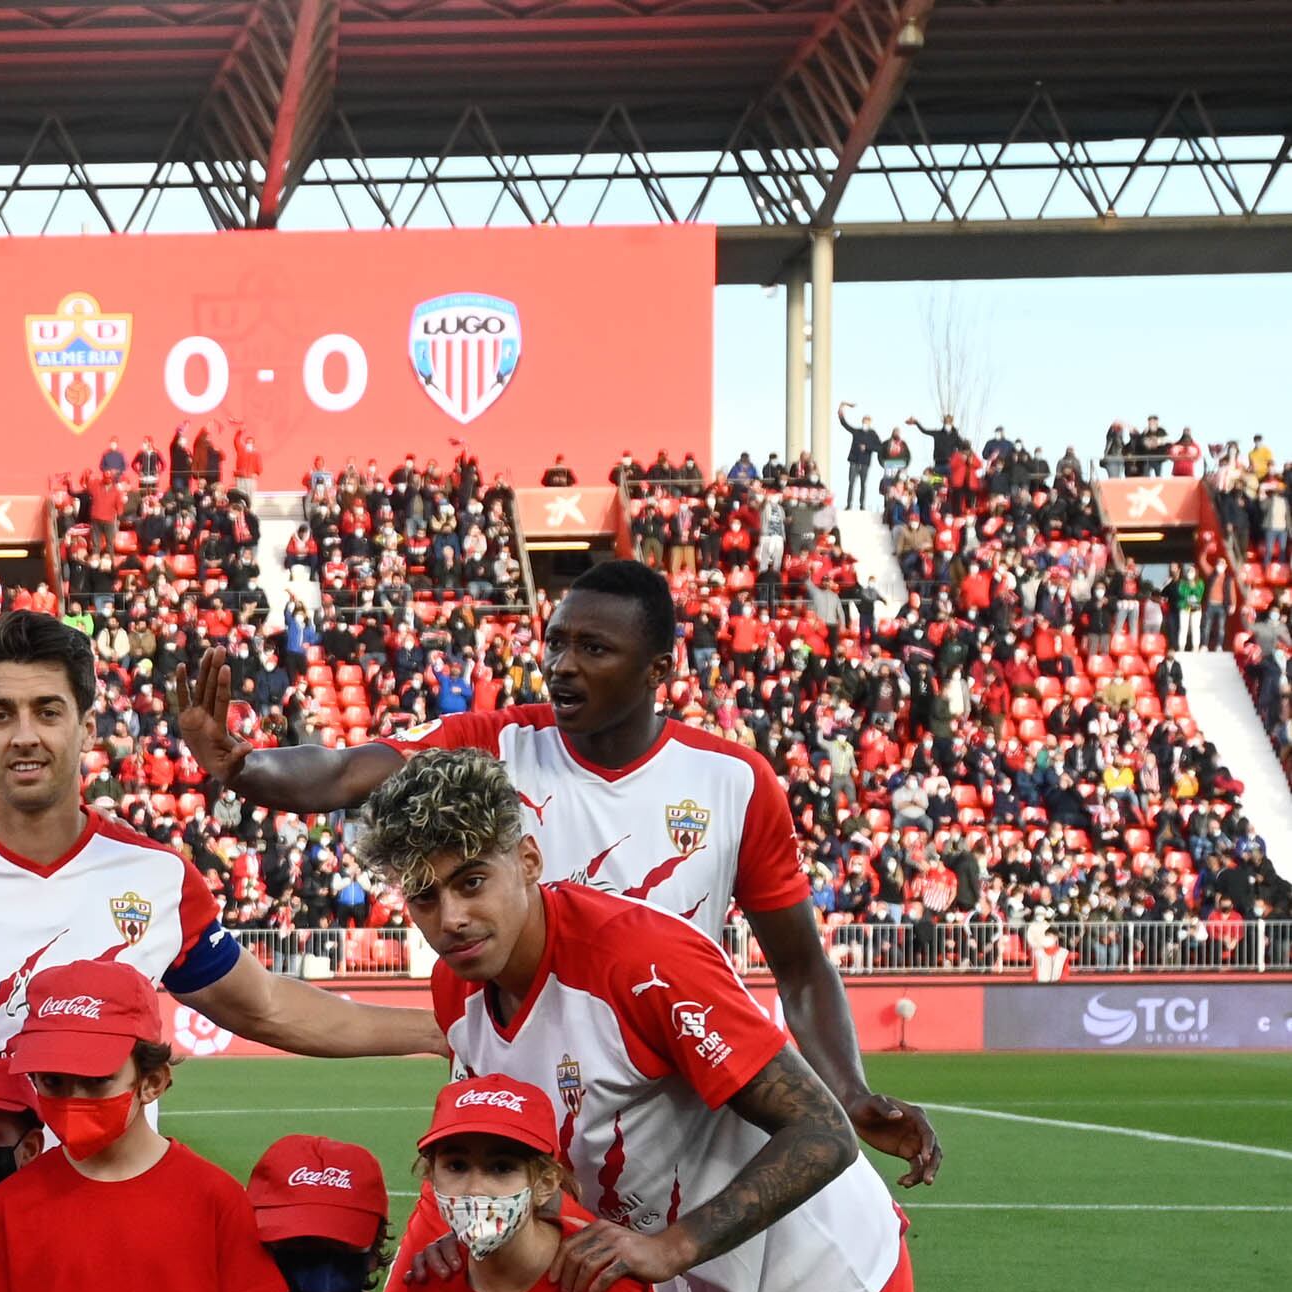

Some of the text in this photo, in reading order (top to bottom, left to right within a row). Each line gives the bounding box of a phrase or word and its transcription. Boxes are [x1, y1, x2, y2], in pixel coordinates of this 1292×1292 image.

[39, 322, 118, 339] U D
[423, 315, 506, 335] LUGO
[38, 351, 119, 367] ALMERIA
[164, 336, 229, 414] 0
[303, 333, 368, 412] 0
[1136, 997, 1209, 1032] TCI
[695, 1031, 724, 1058] PDR
